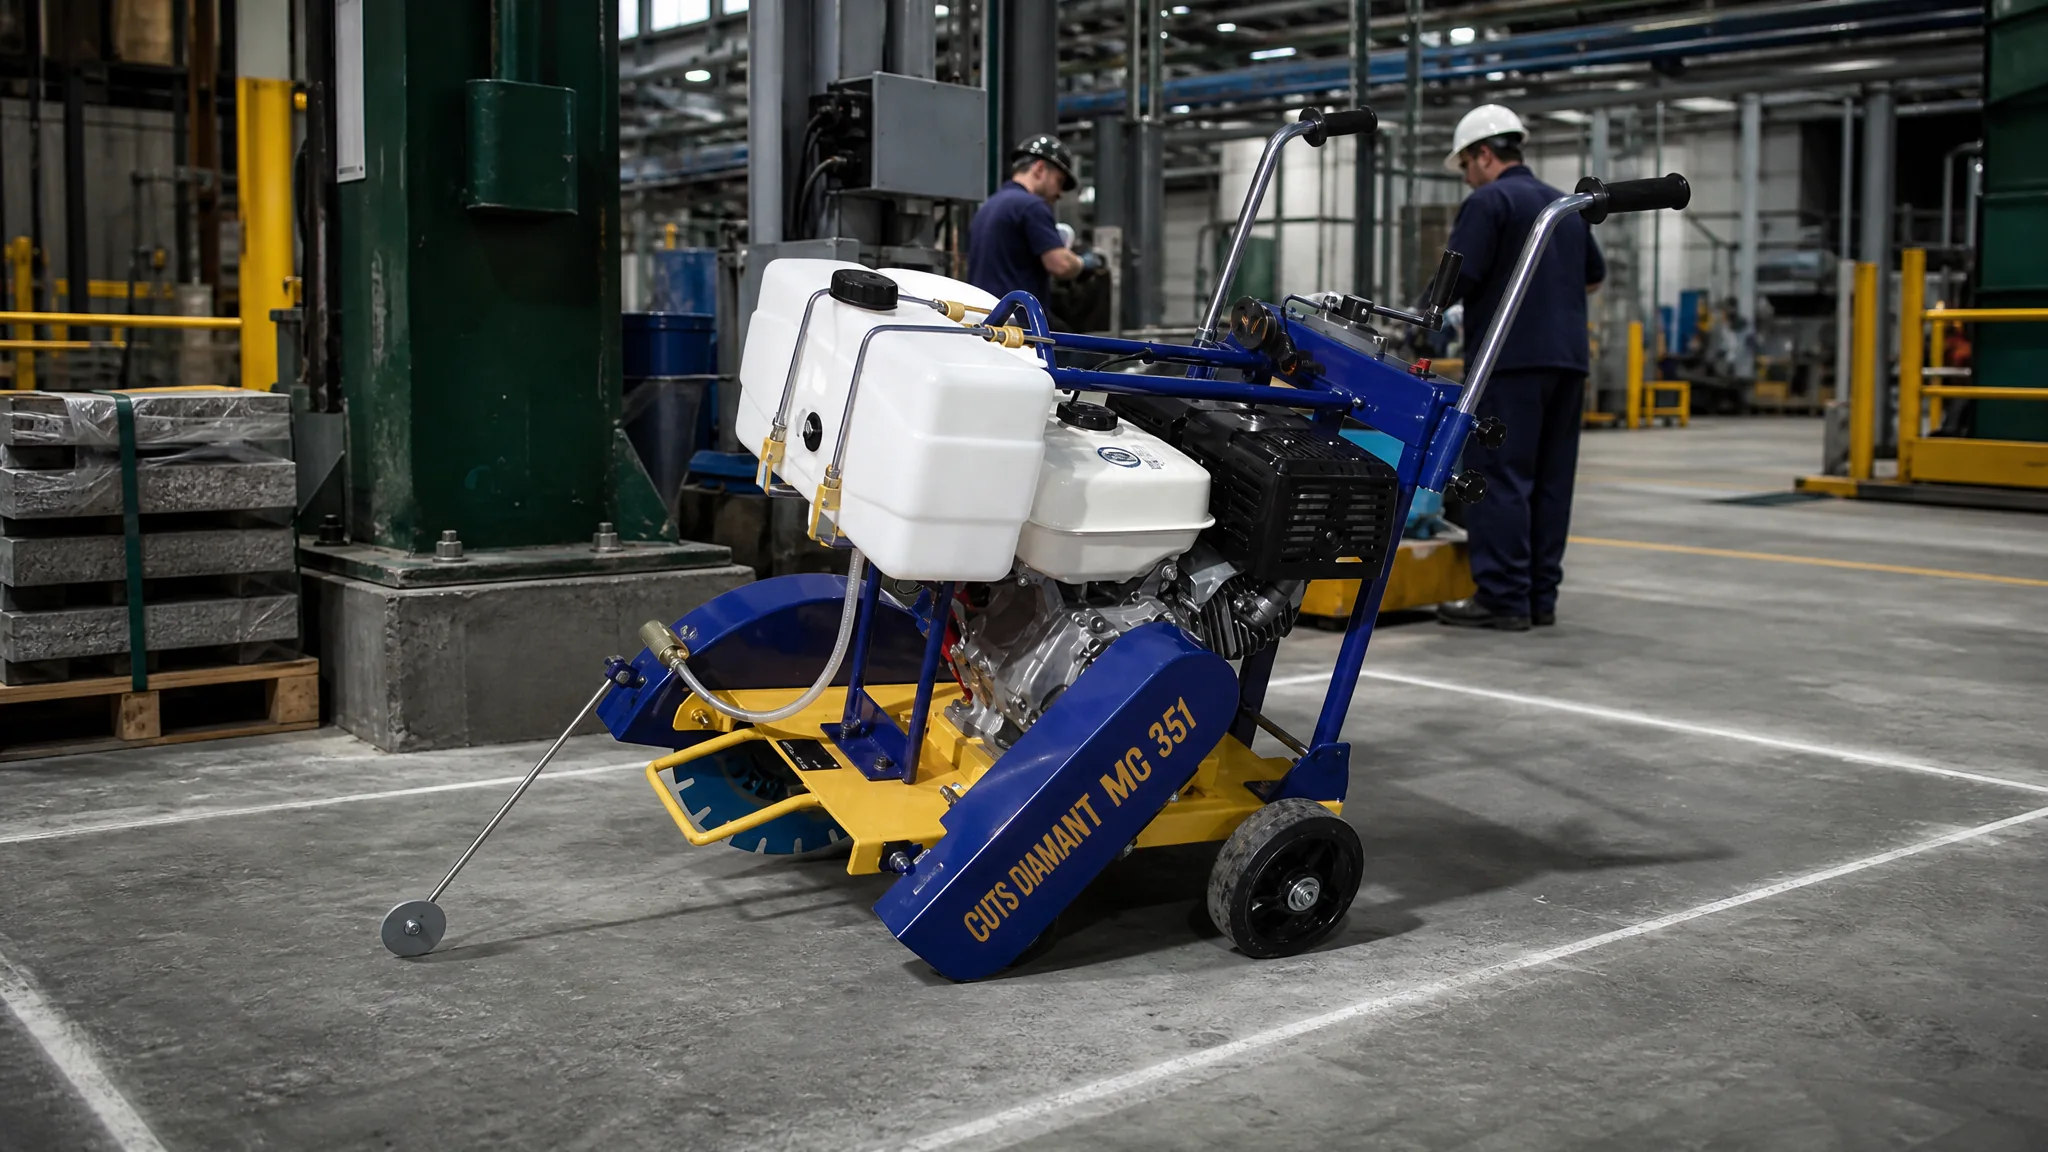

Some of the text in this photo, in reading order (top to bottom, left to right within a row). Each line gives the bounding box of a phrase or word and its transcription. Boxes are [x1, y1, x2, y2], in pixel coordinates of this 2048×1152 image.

[963, 696, 1197, 943] CUTS DIAMANT MC 351
